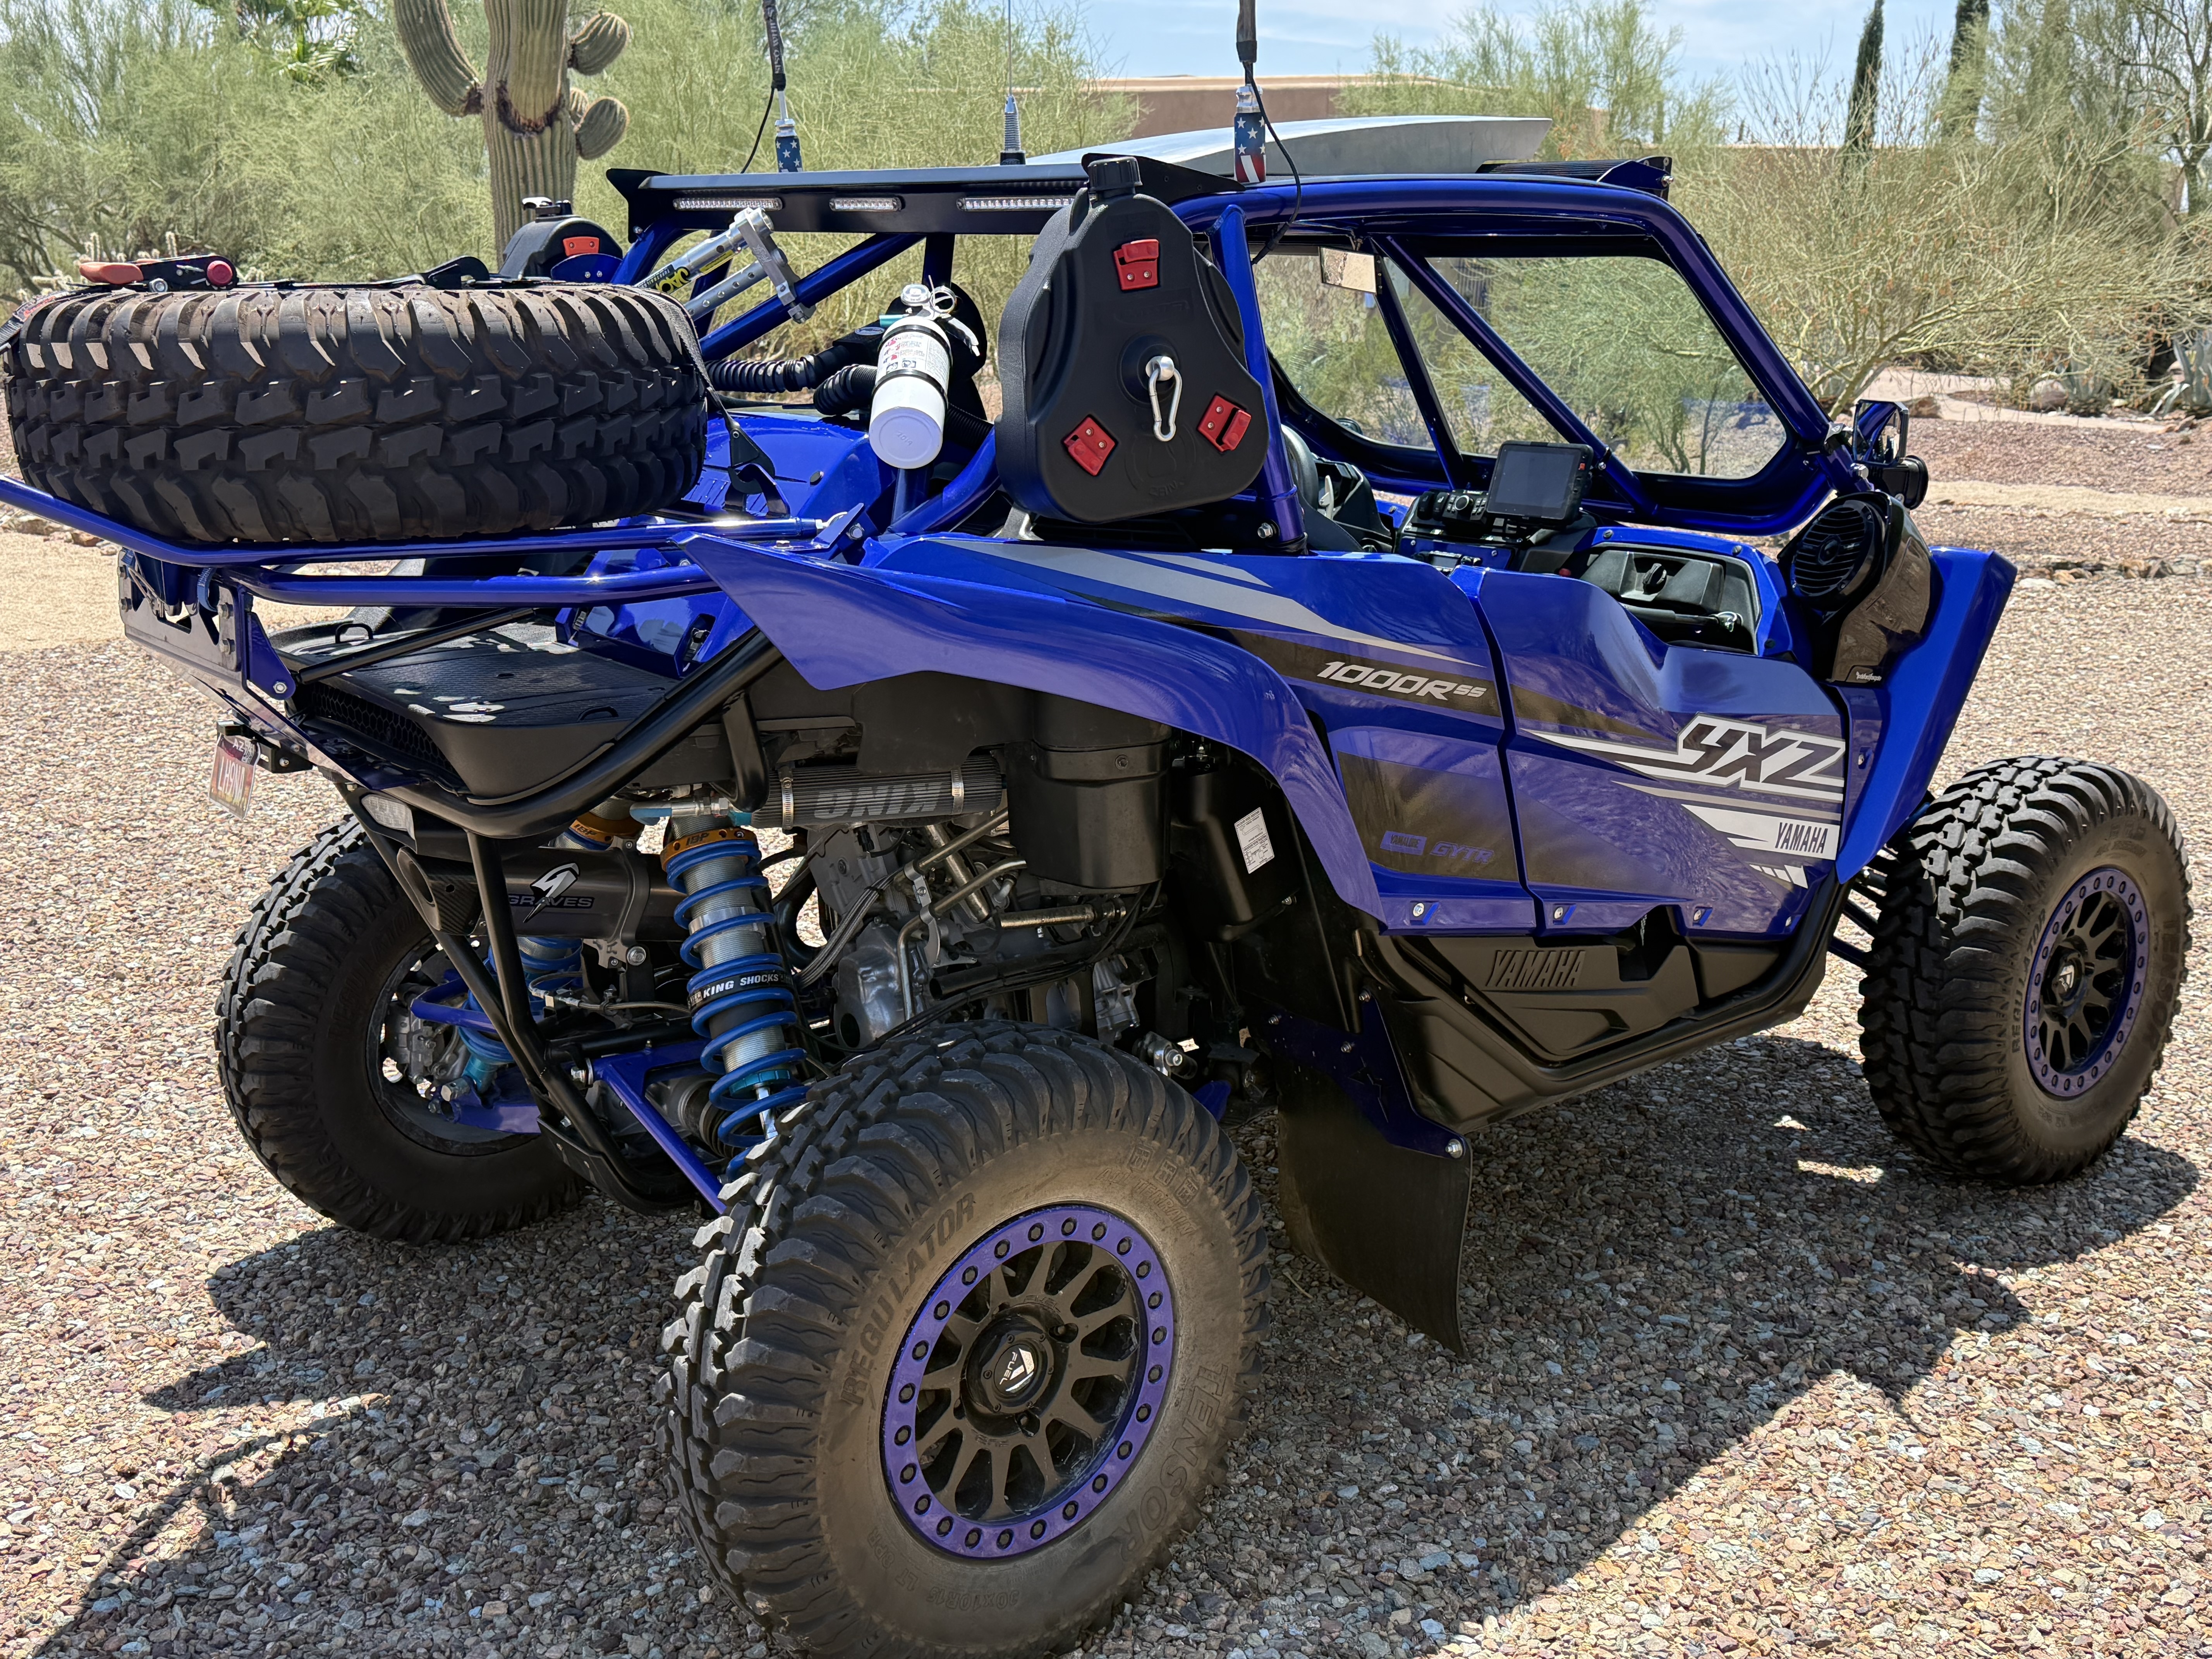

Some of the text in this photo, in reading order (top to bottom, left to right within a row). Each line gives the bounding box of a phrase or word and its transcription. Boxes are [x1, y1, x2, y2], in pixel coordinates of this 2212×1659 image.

[232, 738, 244, 752] AZ
[1680, 721, 1844, 794] YXZ
[1430, 841, 1494, 864] GYTR
[1775, 822, 1828, 854] YAMAHA
[703, 980, 735, 999] KING
[740, 974, 779, 986] SHOCKS
[1485, 950, 1586, 987] YAMAHA
[2011, 908, 2045, 1053] REGULATOR
[1134, 1179, 1197, 1235] TERRAIN
[840, 1192, 974, 1406] REGULATOR
